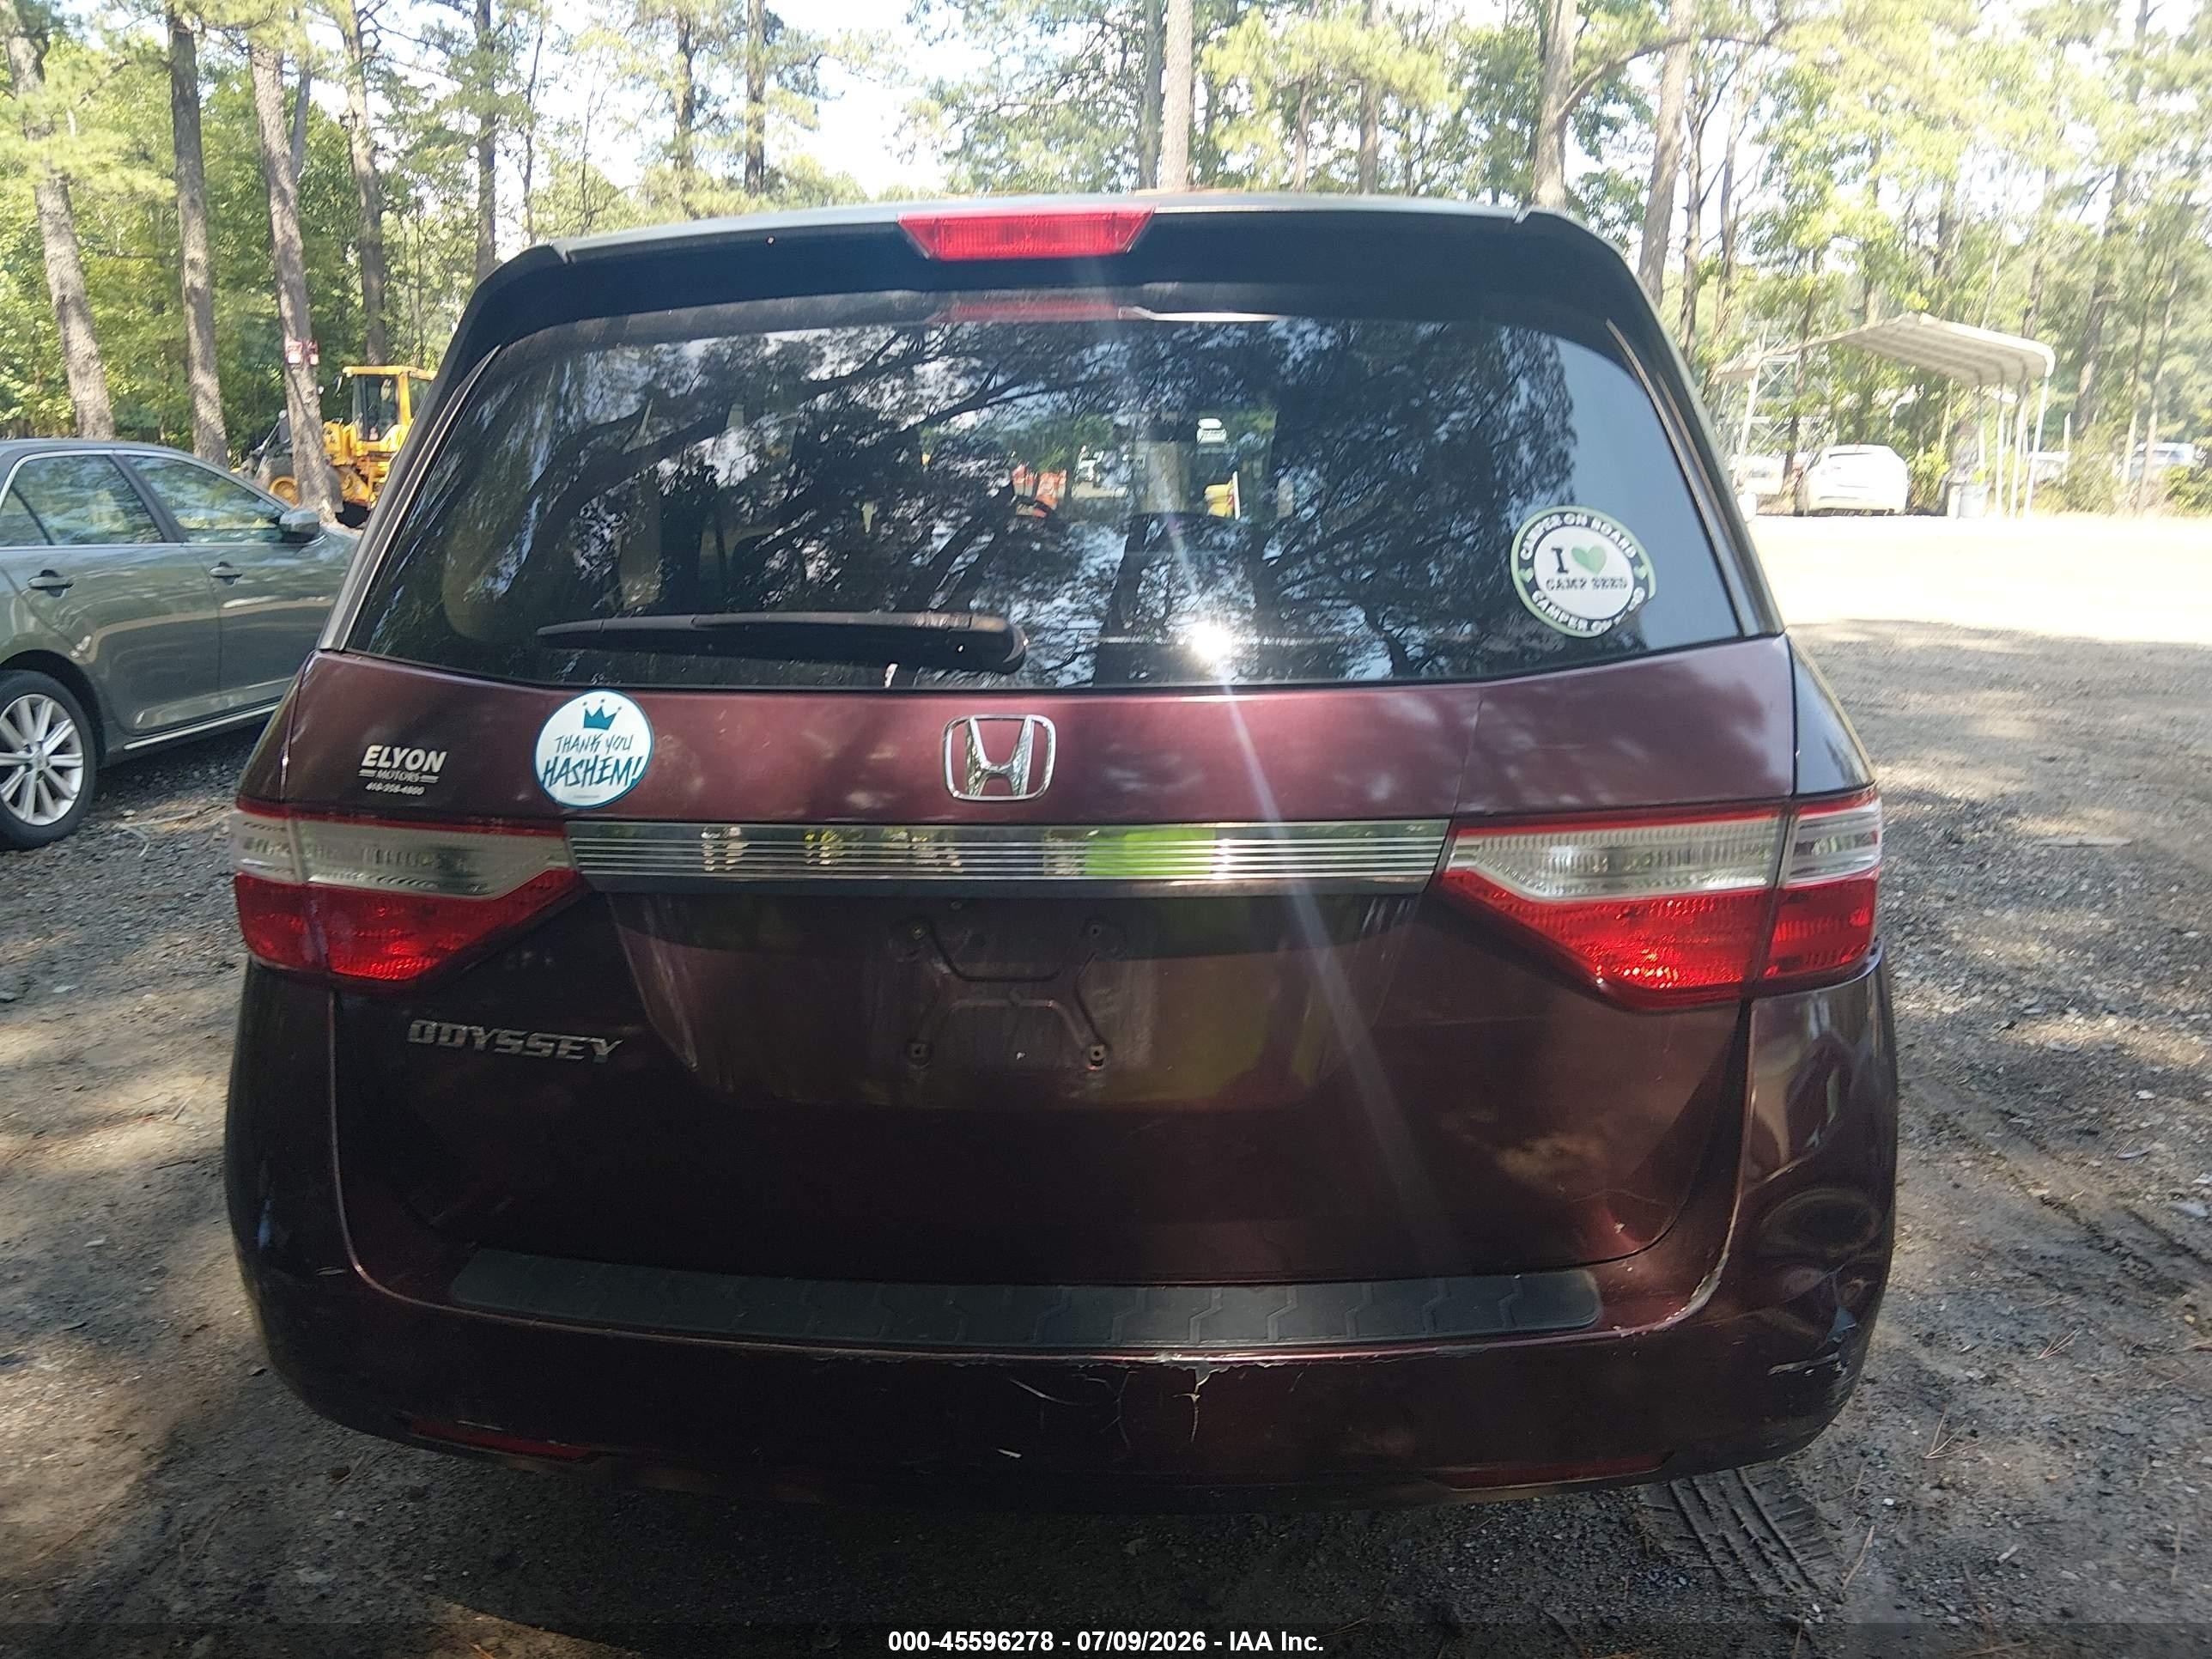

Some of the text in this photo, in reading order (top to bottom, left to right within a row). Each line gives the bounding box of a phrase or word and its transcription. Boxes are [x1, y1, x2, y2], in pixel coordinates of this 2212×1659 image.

[1564, 513, 1588, 526] ON
[1590, 516, 1638, 558] BOARD
[1551, 547, 1569, 574] I
[1546, 577, 1587, 591] CAMP
[1532, 590, 1588, 631] CAMPER
[555, 733, 634, 754] THANK YOU
[362, 744, 447, 773] ELYON
[543, 755, 643, 788] HASHEM!
[375, 769, 421, 782] MOTORS
[407, 1020, 623, 1064] ODYSSEY
